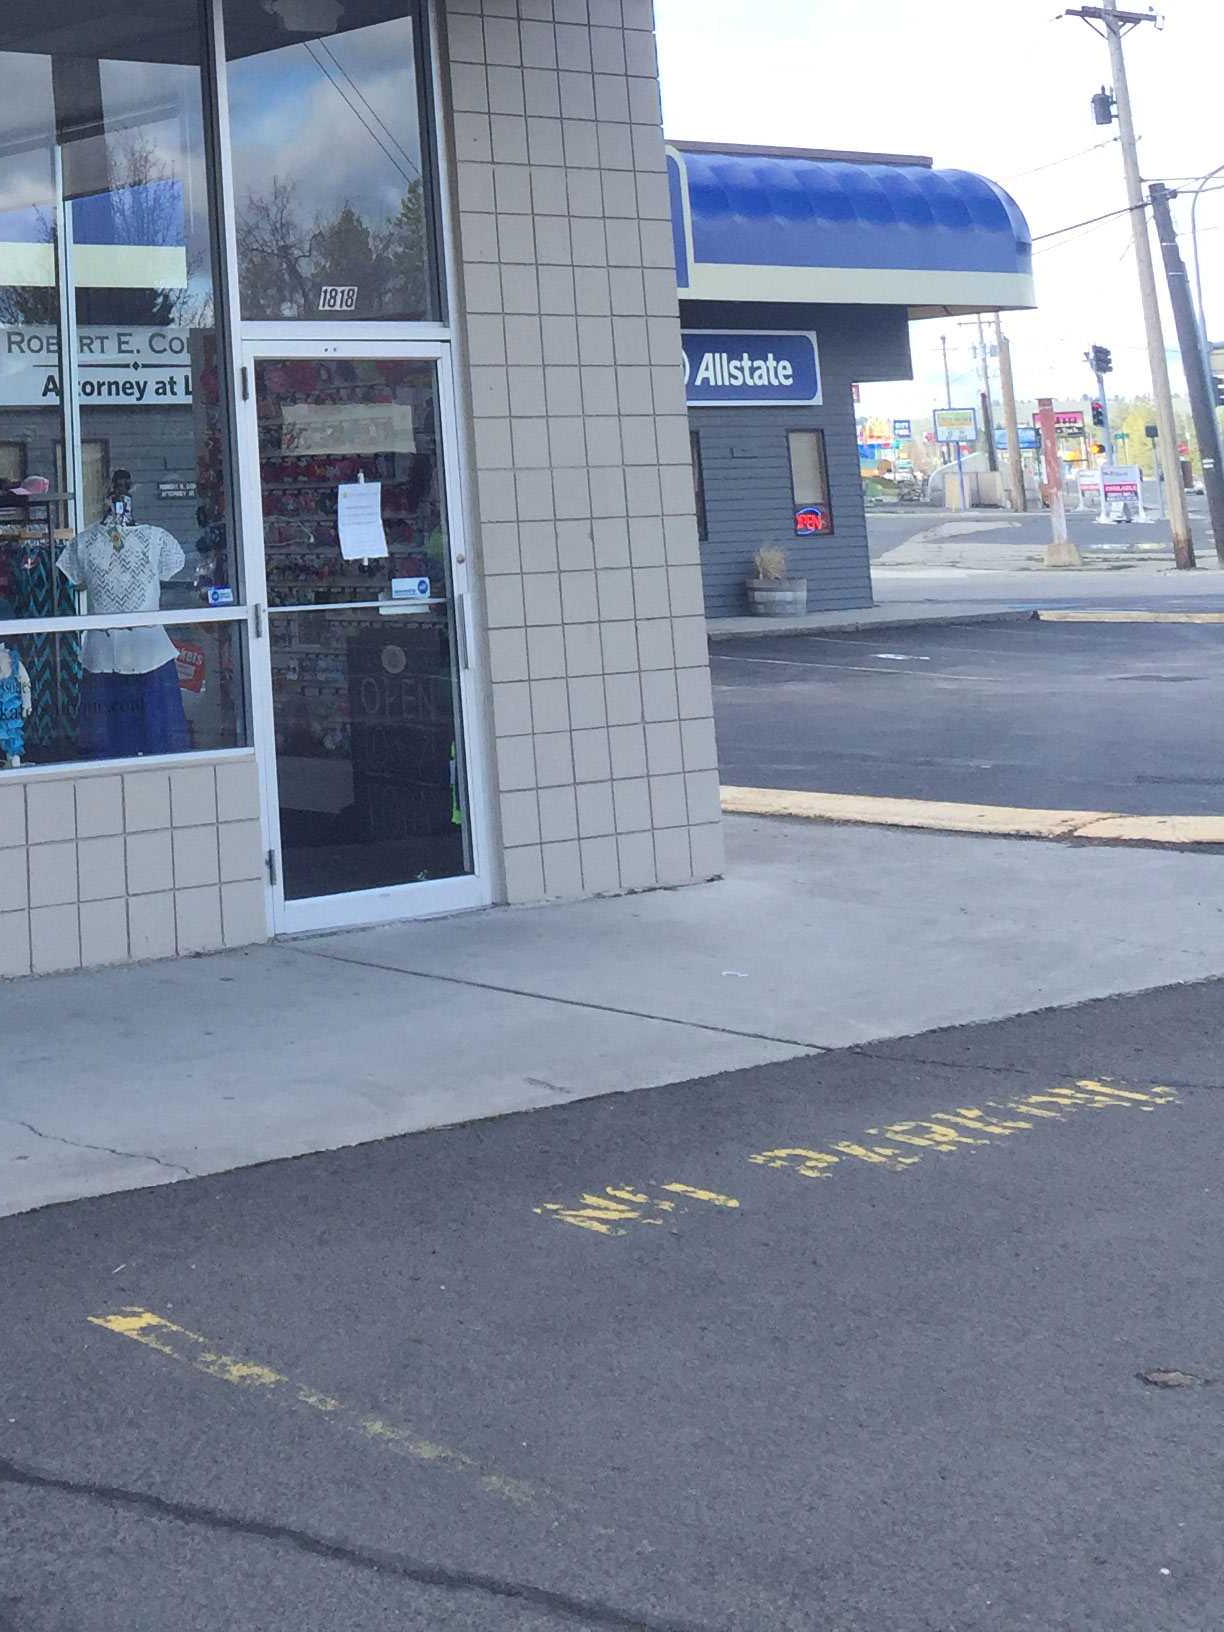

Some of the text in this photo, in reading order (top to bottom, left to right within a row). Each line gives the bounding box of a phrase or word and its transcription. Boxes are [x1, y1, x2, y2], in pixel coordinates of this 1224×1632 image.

[321, 287, 356, 309] 1818
[6, 330, 110, 355] ROBRT
[116, 332, 141, 355] E.
[694, 352, 794, 387] Allstate
[41, 374, 148, 402] Aorney
[154, 376, 178, 397] at
